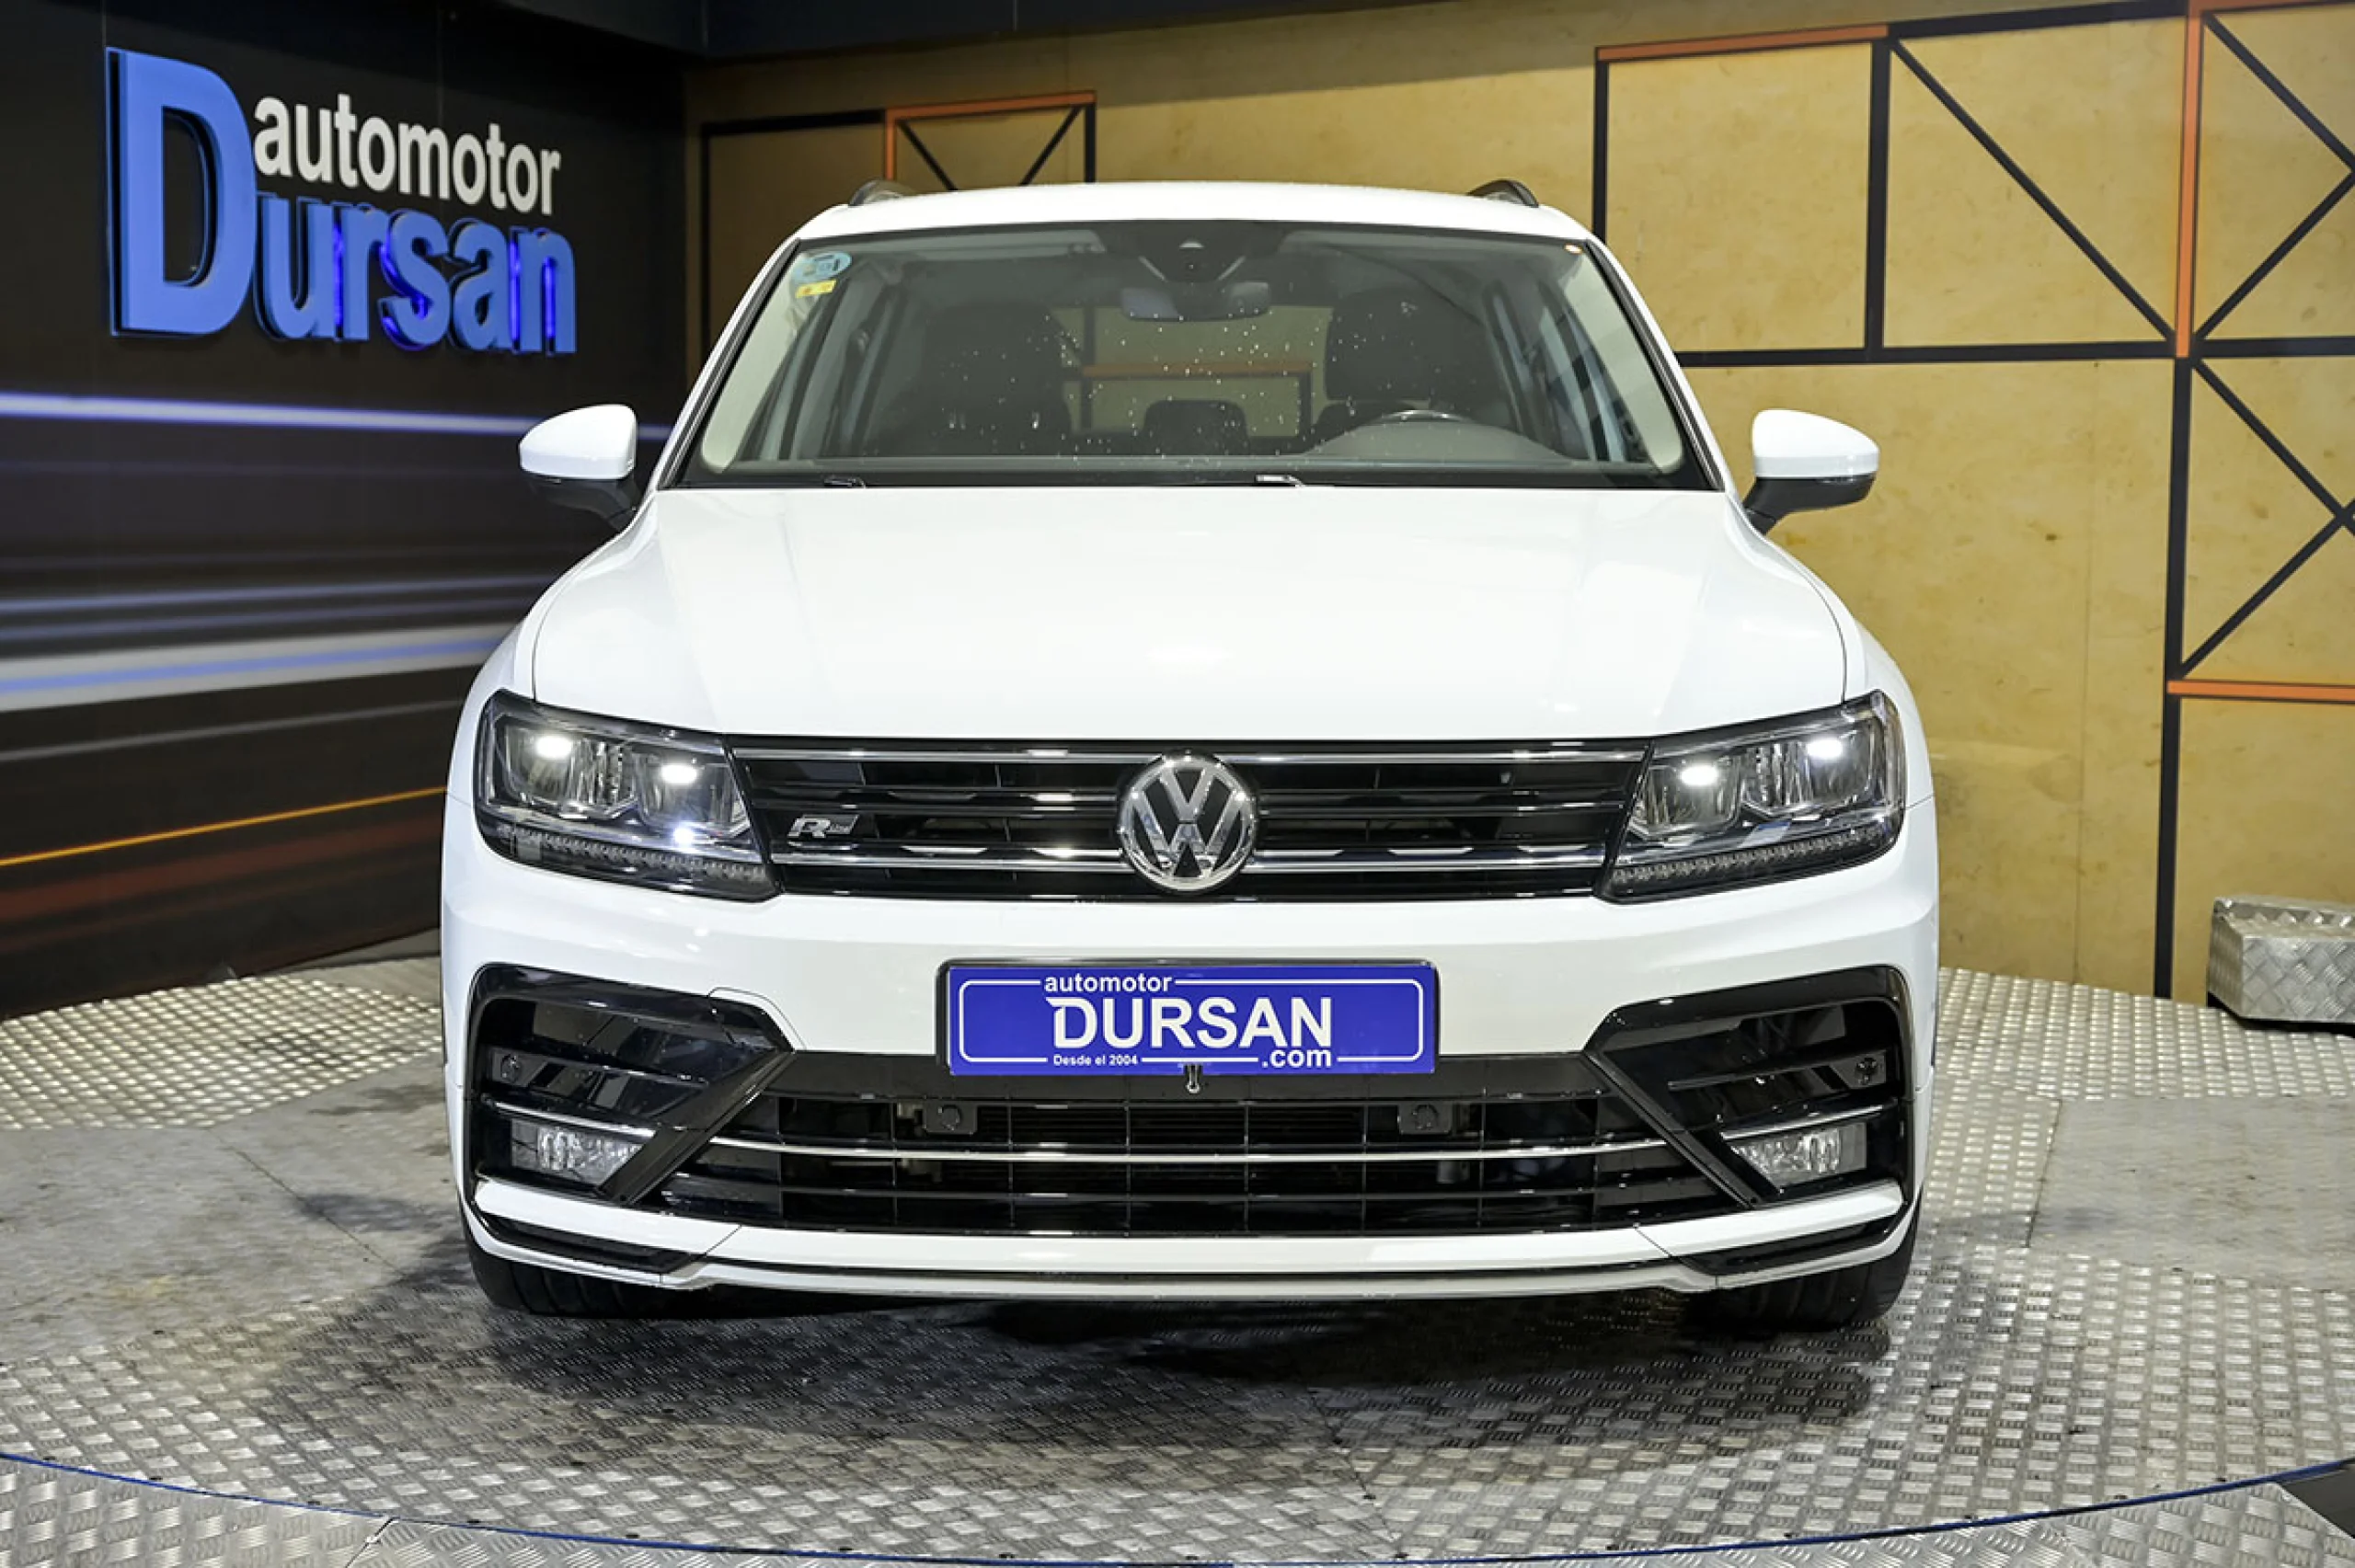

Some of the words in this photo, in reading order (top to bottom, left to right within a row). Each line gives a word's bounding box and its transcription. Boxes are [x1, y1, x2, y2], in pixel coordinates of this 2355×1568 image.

[254, 94, 561, 214] automotor
[106, 46, 578, 354] Dursan
[1121, 752, 1256, 890] VW
[1044, 974, 1172, 992] automotor
[1046, 996, 1332, 1048] DURSAN
[1053, 1054, 1092, 1066] Desde
[1095, 1054, 1106, 1066] el
[1109, 1054, 1138, 1066] 2004
[1261, 1047, 1332, 1069] .com
